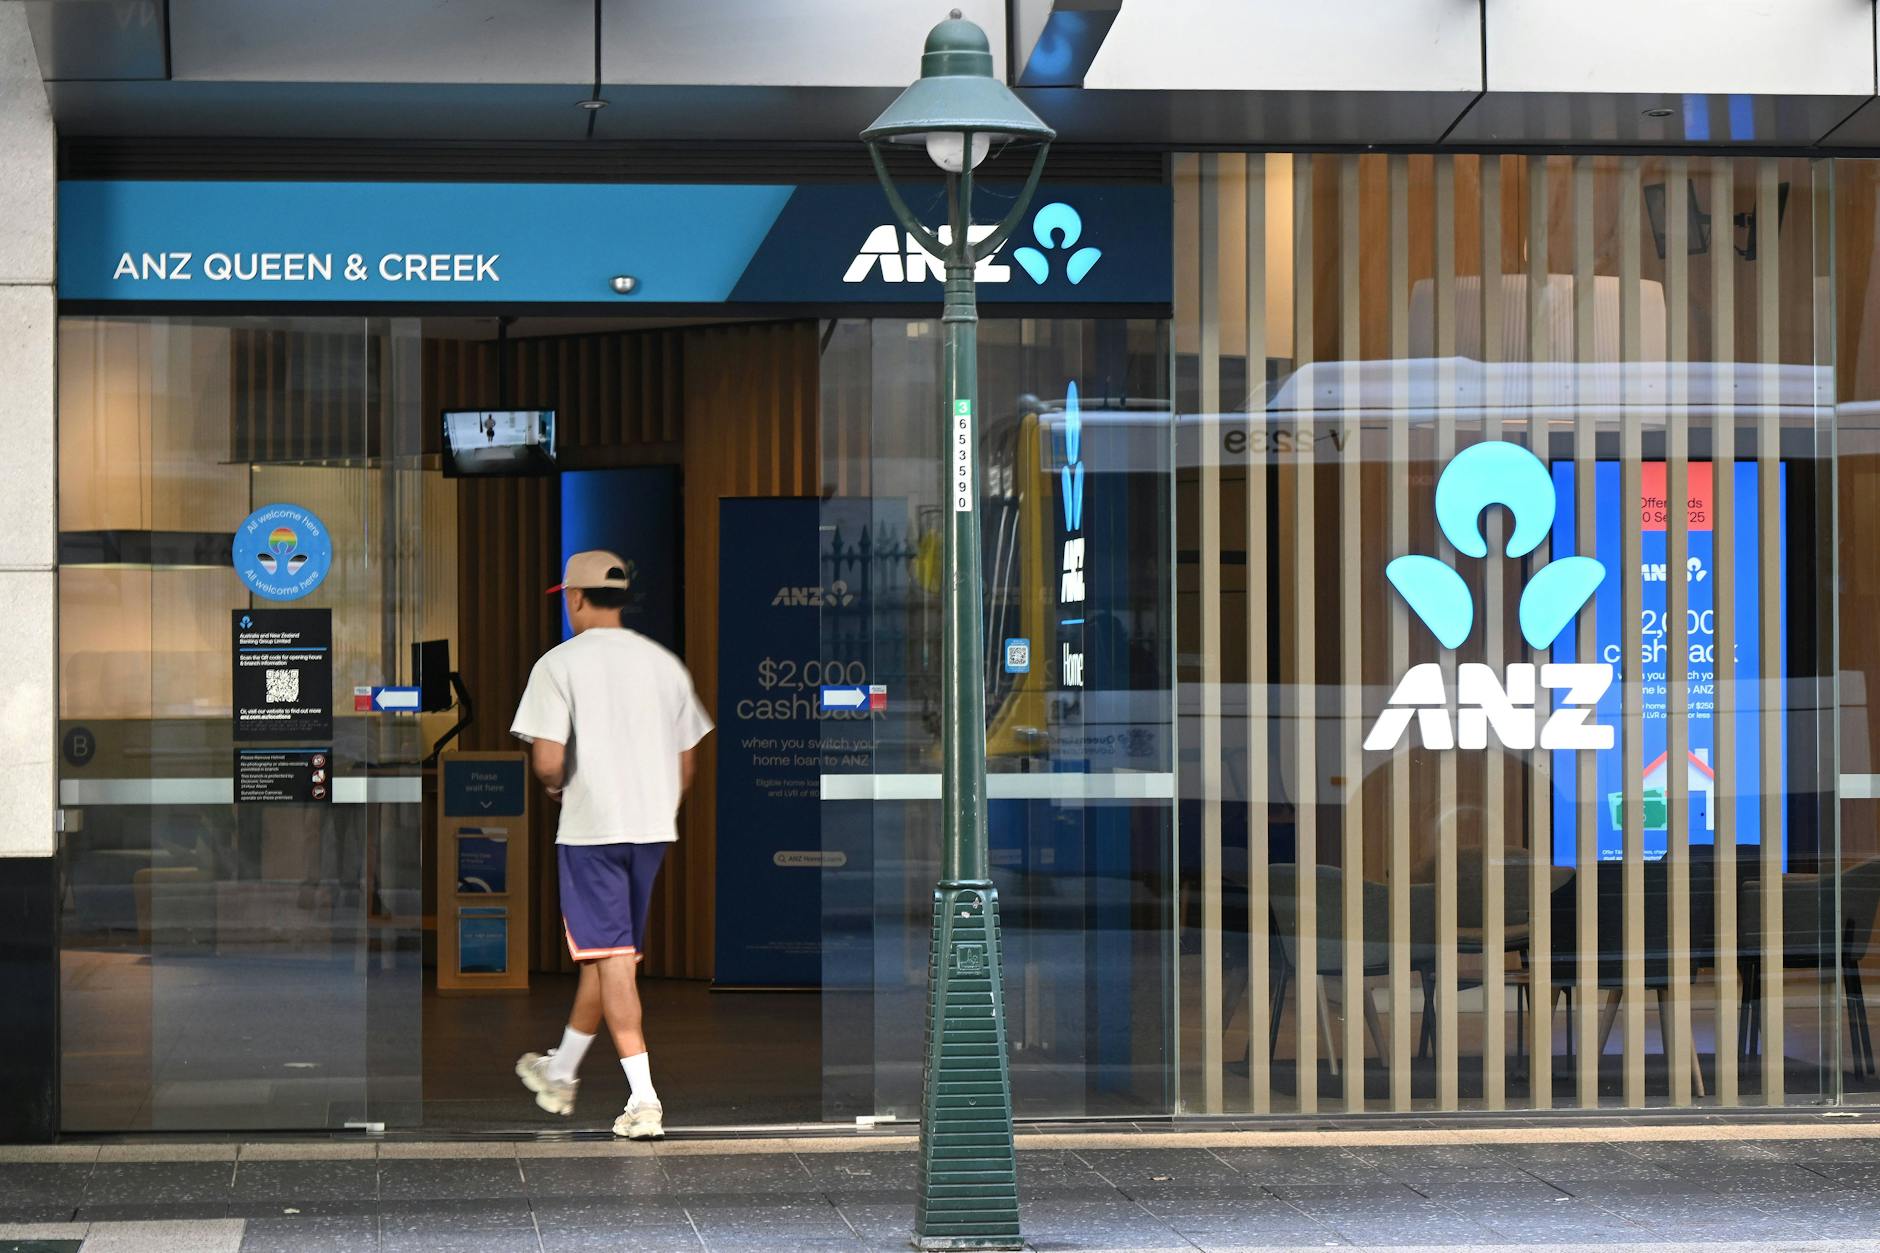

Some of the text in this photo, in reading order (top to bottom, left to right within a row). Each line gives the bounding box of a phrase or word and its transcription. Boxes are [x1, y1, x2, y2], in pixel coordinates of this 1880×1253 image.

[113, 252, 500, 282] ANZ QUEEN & CREEK
[842, 224, 1011, 283] ANZ
[247, 510, 320, 537] All welcome here
[245, 568, 320, 596] All welcome here
[771, 586, 825, 607] ANZ
[757, 656, 867, 692] $2,000
[1063, 642, 1084, 687] Home
[1362, 662, 1615, 751] ANZ
[73, 735, 88, 757] B
[742, 737, 881, 751] when you switch your
[753, 754, 869, 766] home loan to ANZ
[485, 783, 505, 793] here
